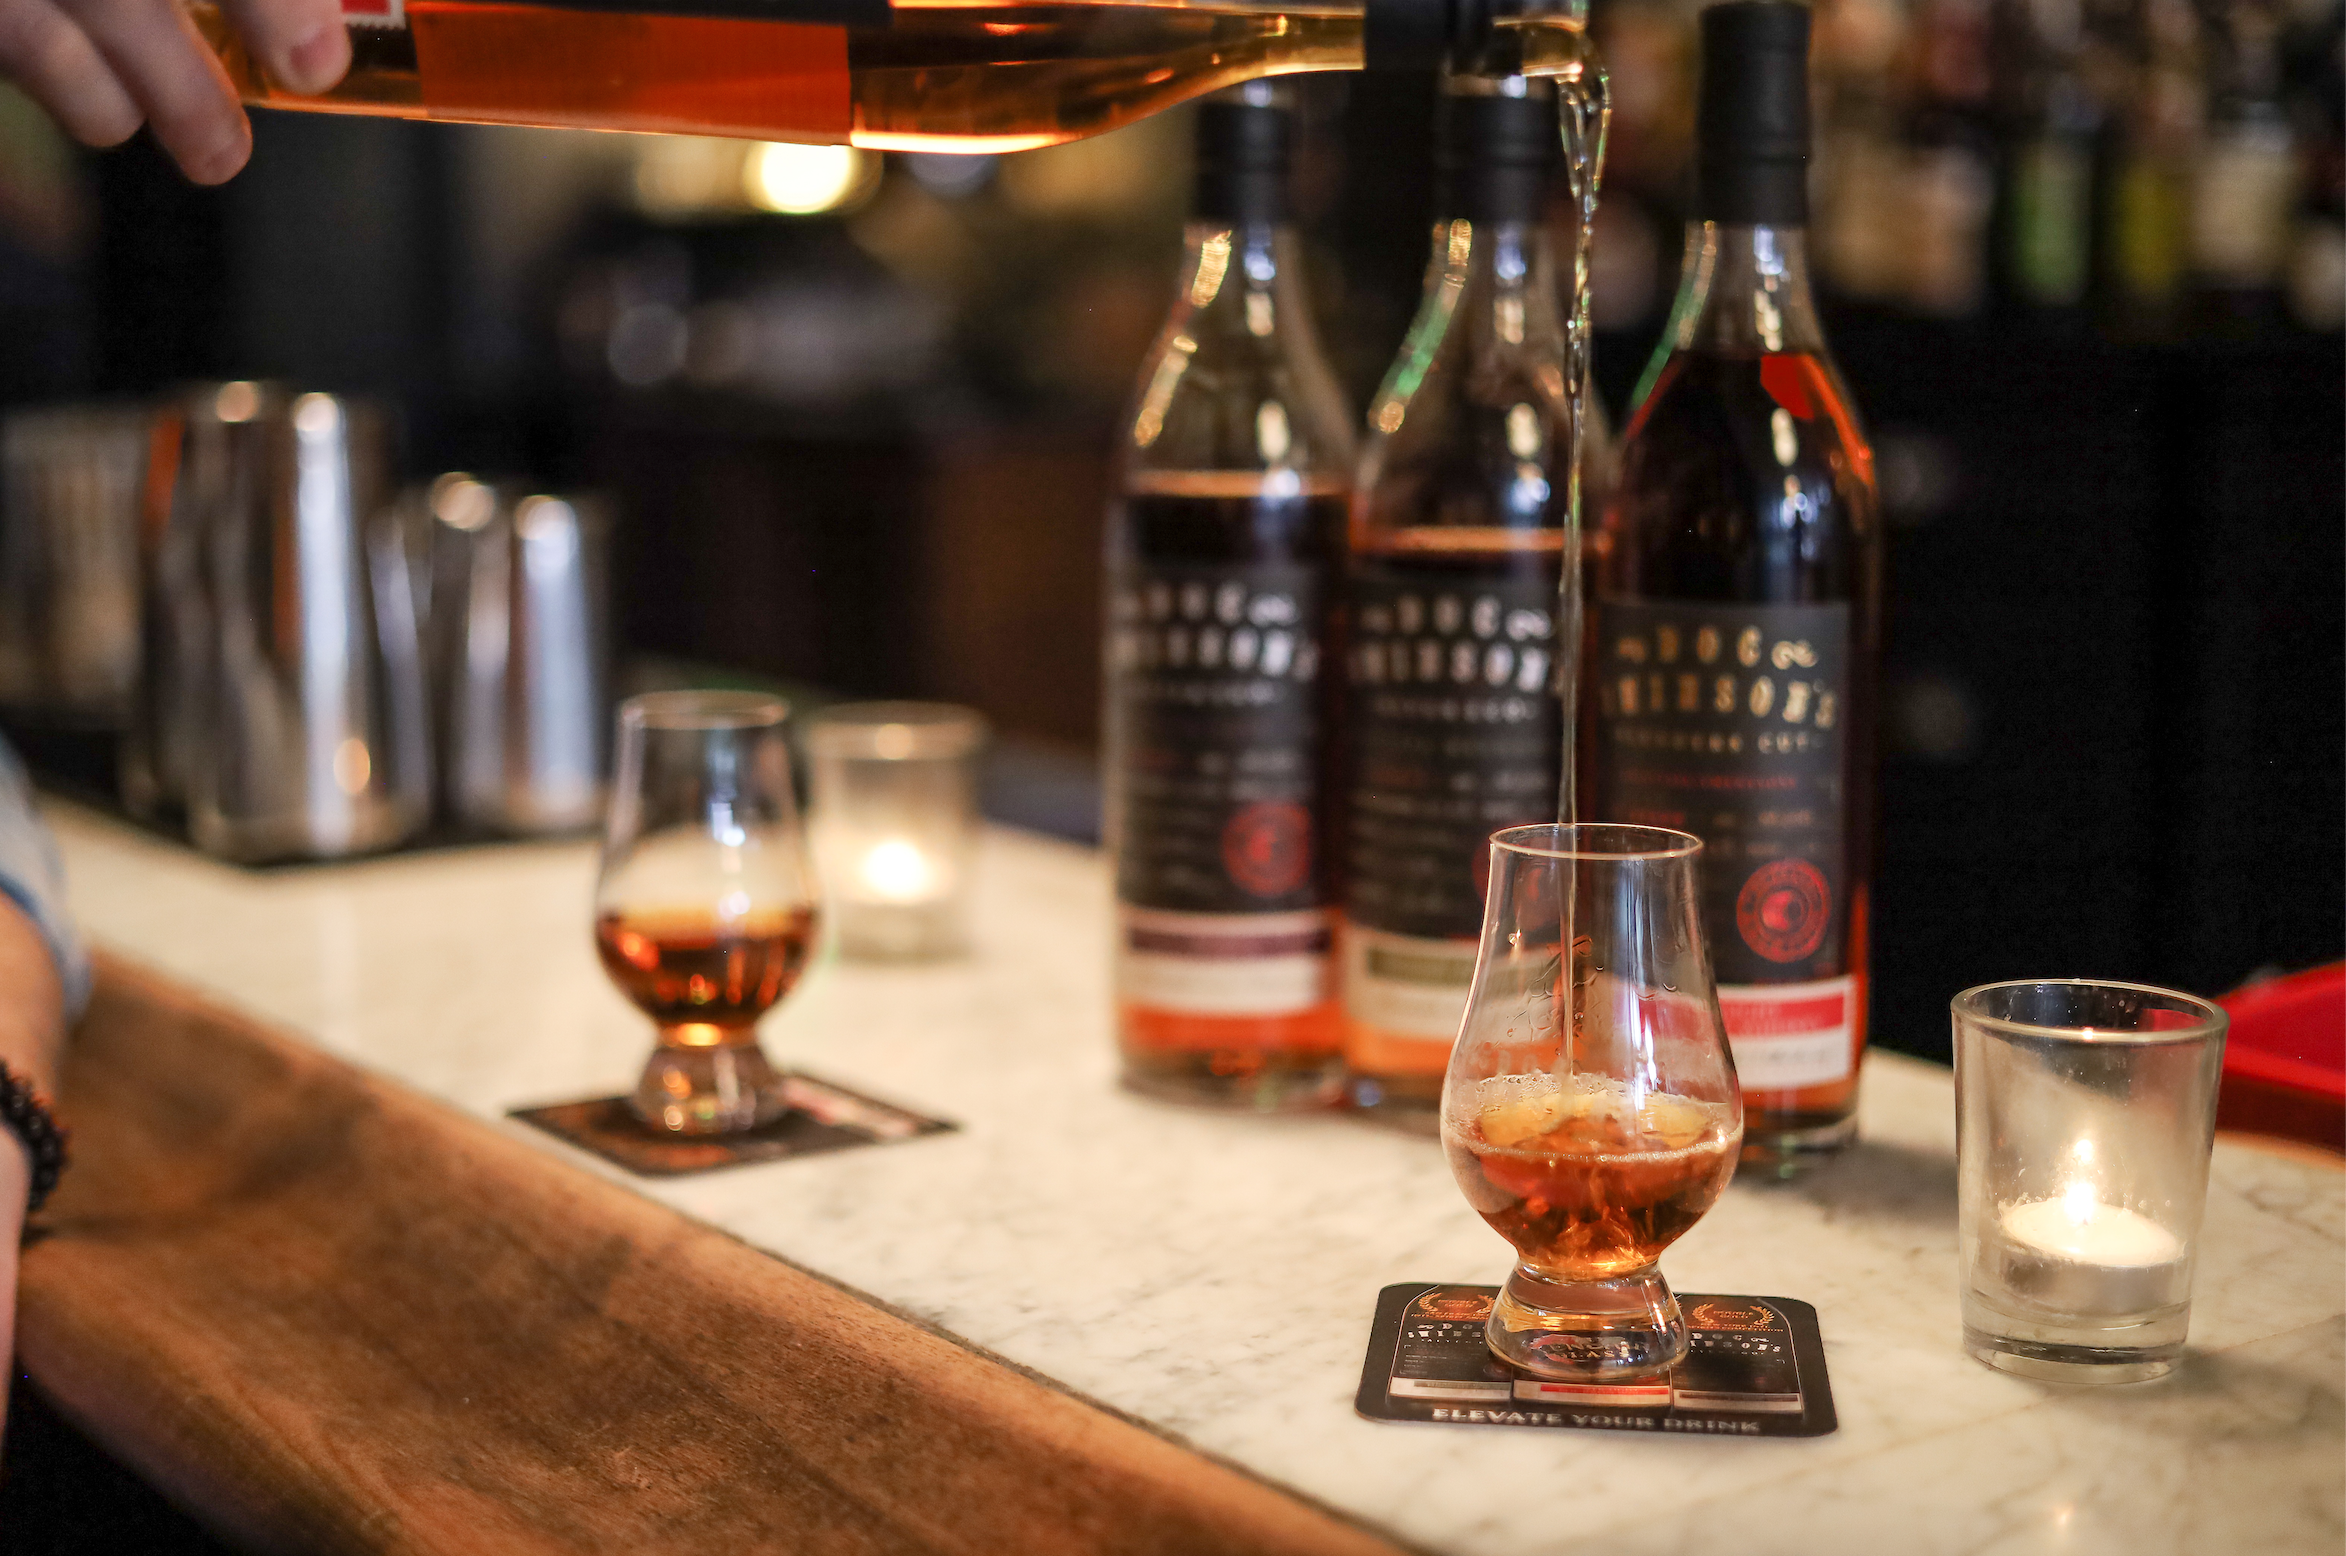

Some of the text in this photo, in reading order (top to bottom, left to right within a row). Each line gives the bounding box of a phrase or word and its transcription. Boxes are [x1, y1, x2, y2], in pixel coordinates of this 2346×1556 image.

[1690, 1341, 1781, 1353] INSON'S
[1433, 1408, 1761, 1432] ELEVATE YOUR DRINK
